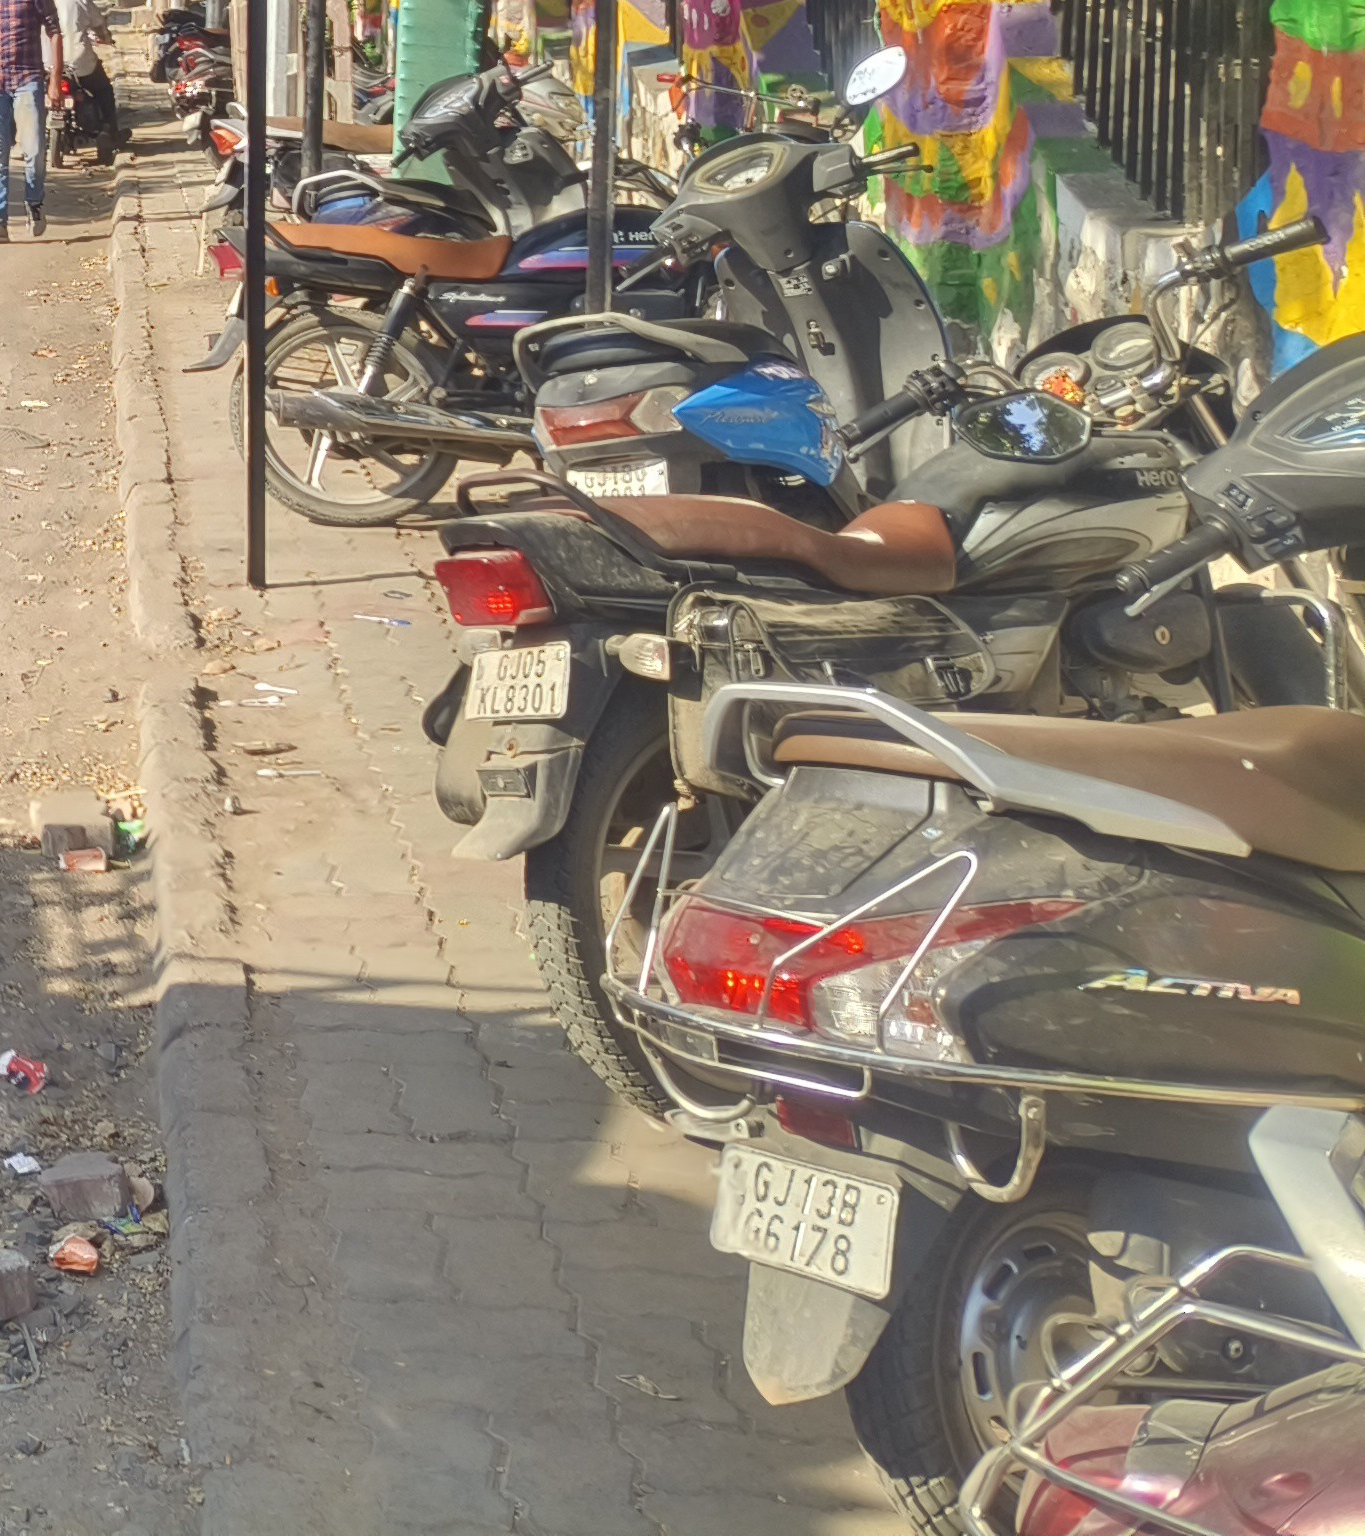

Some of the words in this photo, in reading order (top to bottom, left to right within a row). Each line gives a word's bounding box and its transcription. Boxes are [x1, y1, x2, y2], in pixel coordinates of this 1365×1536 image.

[1135, 469, 1179, 486] Hero
[497, 649, 546, 681] GJ05
[476, 682, 557, 715] KL8301
[754, 1161, 862, 1227] GJ13B
[744, 1207, 851, 1277] G6178
